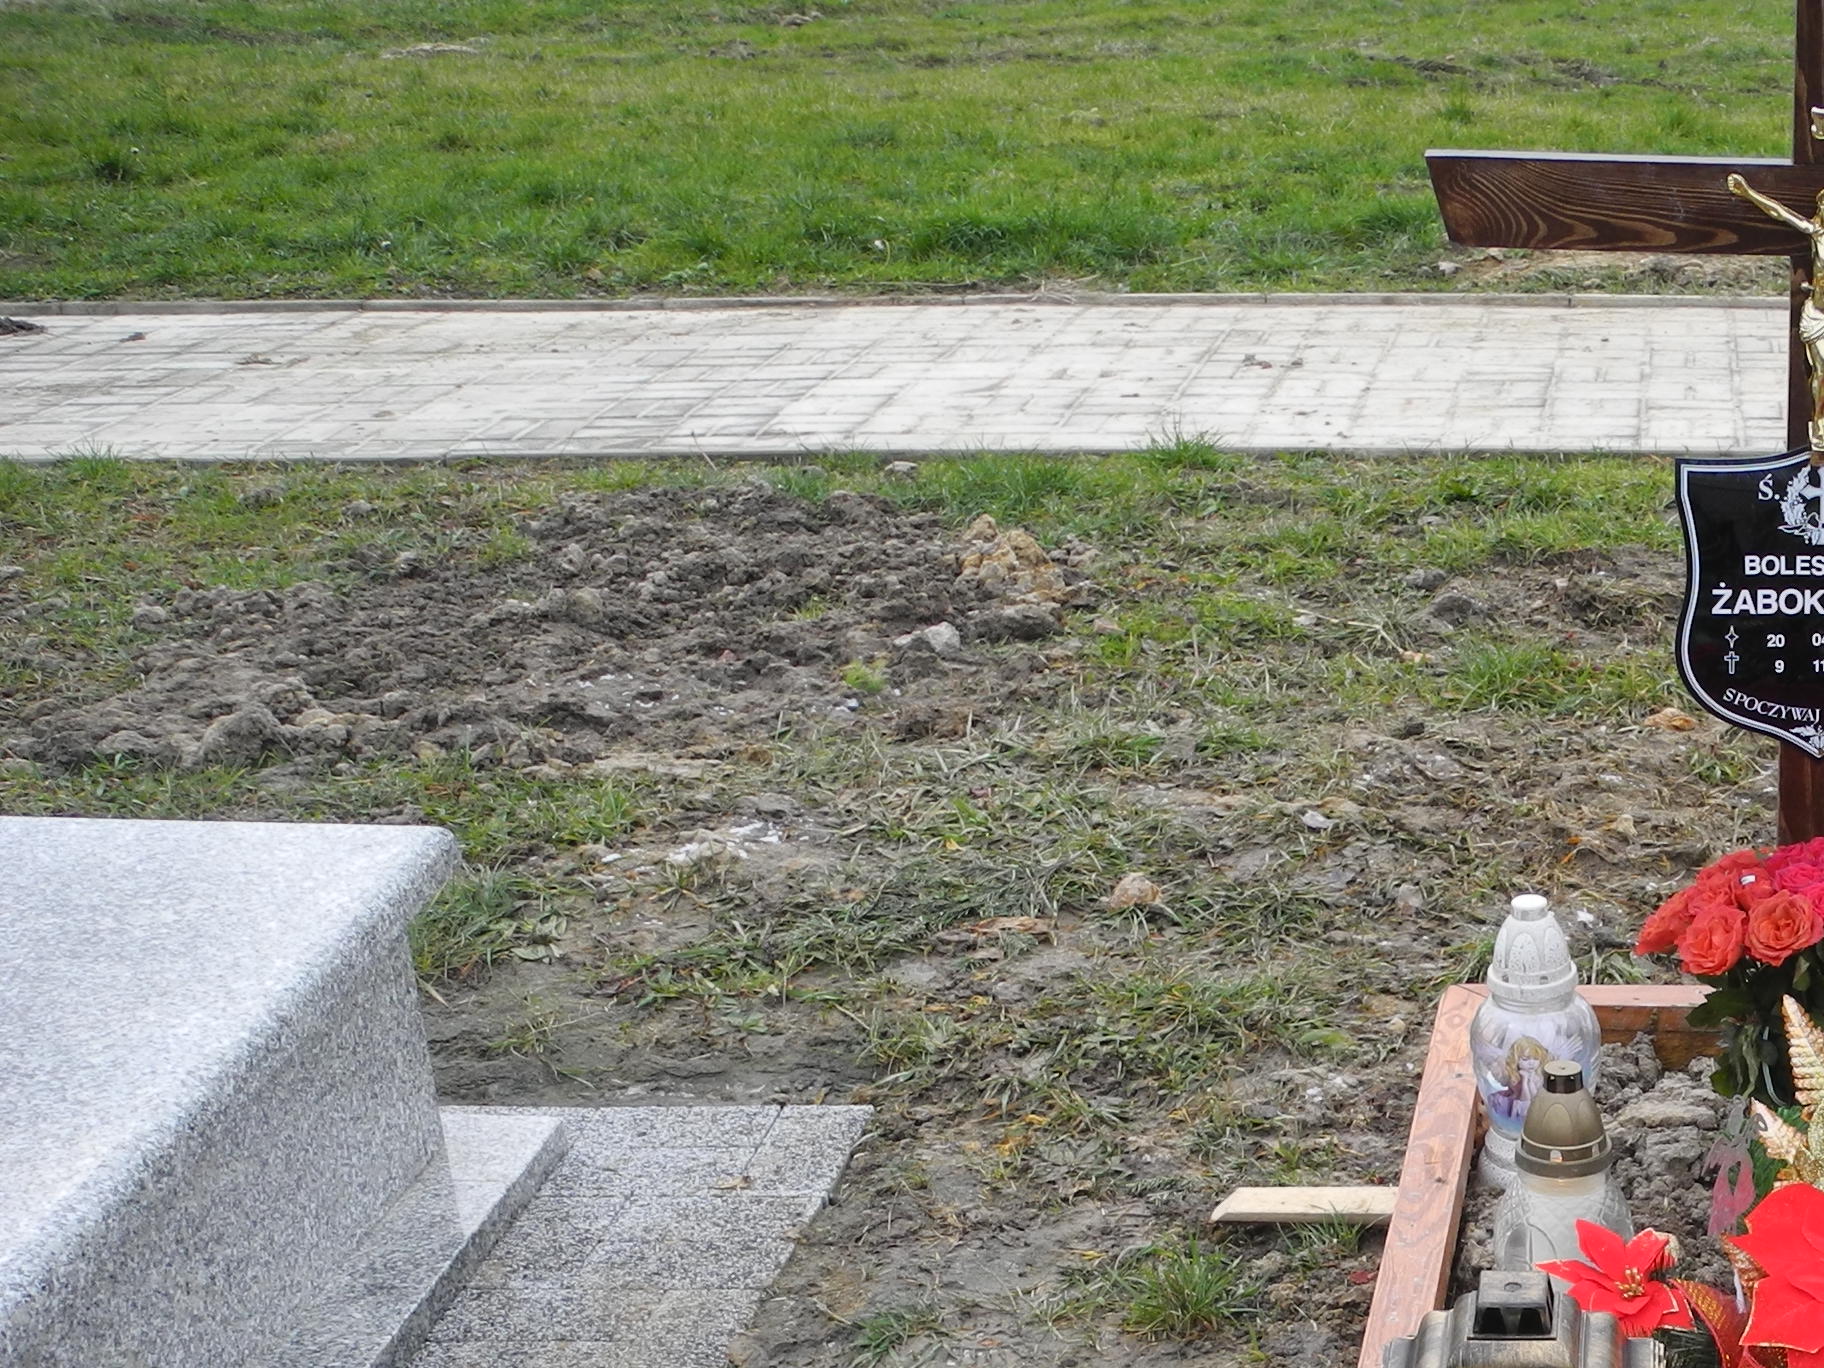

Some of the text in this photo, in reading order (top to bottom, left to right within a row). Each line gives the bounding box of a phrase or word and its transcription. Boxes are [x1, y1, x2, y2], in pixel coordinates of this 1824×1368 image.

[1758, 474, 1781, 501] Ś.
[1766, 633, 1786, 648] 20
[1774, 659, 1785, 674] 9
[1722, 686, 1820, 724] SPOCZYWAJ
